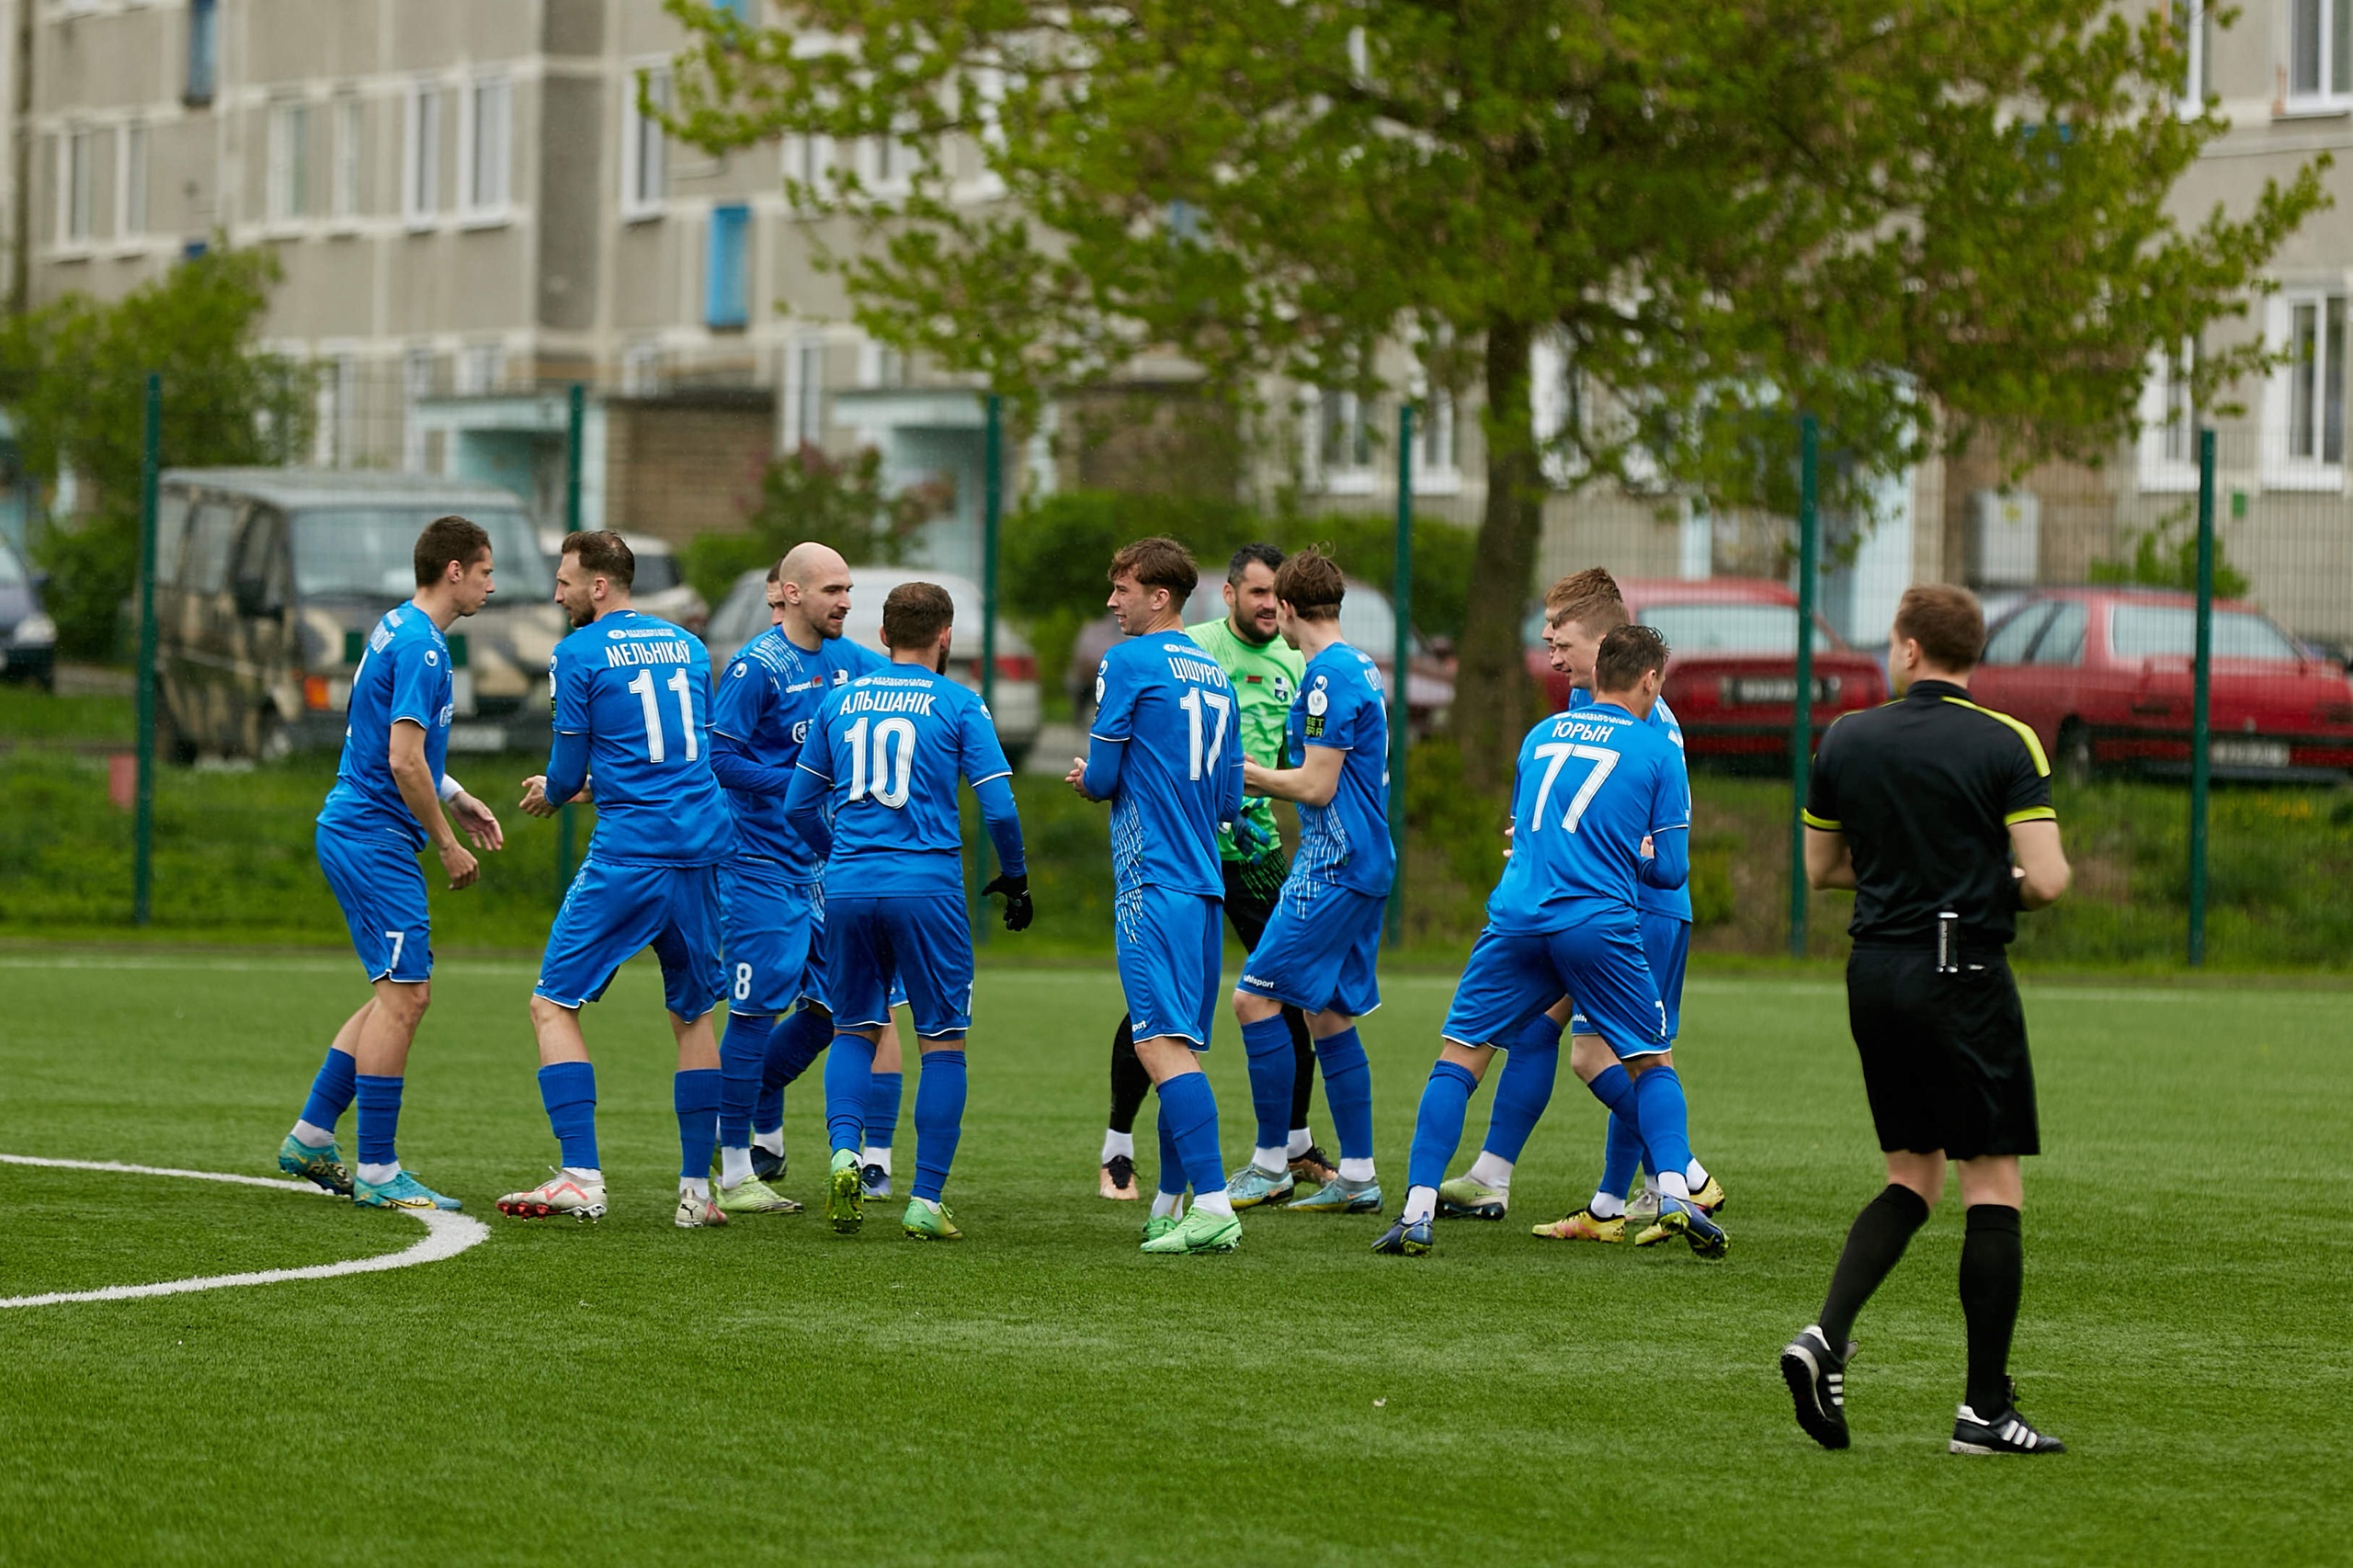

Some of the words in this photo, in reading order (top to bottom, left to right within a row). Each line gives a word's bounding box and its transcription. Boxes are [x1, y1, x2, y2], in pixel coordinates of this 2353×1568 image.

[628, 667, 698, 763] 11
[839, 691, 937, 717] АЛЬШАНІК
[1180, 687, 1231, 781] 17
[1552, 721, 1615, 744] ЮРЫН
[844, 717, 917, 809] 10
[1532, 742, 1620, 834] 77
[385, 931, 404, 968] 7
[734, 962, 752, 1000] 8
[1243, 974, 1275, 988] uhlsport
